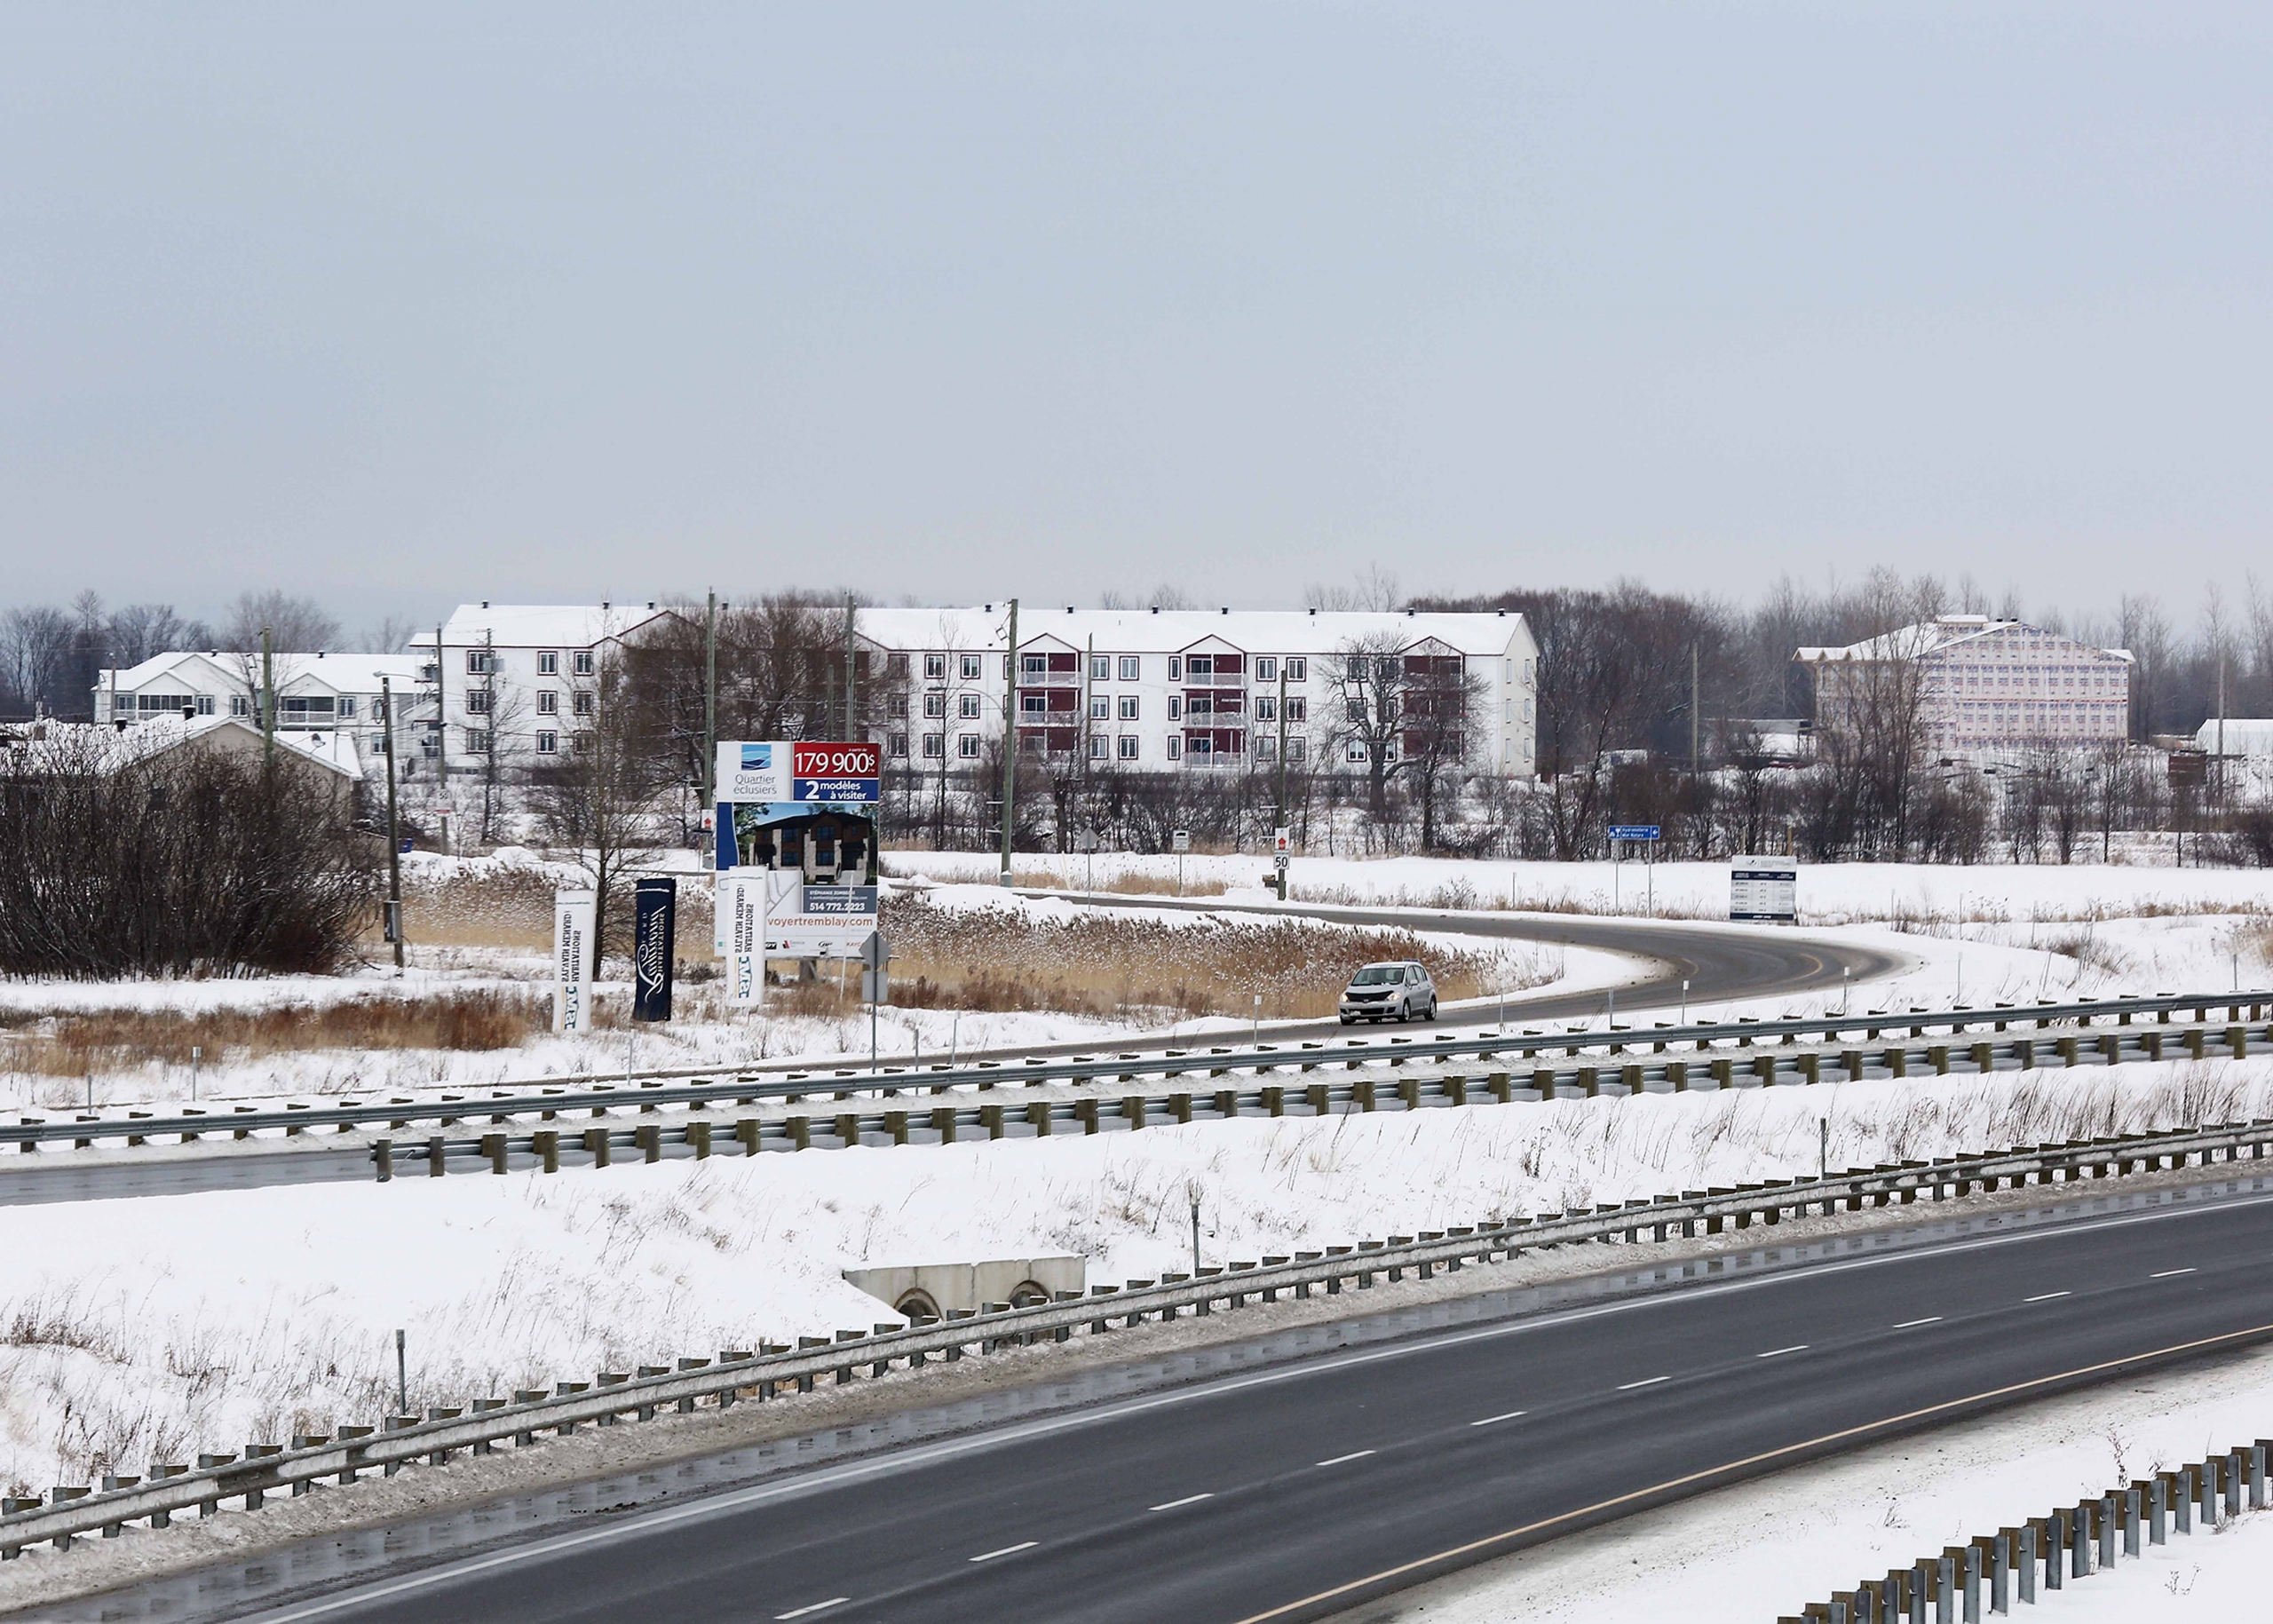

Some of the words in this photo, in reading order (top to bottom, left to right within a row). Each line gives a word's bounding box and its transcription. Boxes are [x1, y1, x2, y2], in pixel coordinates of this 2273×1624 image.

[795, 752, 828, 773] 179
[832, 752, 875, 773] 900$
[735, 774, 775, 785] Quartier
[733, 784, 777, 794] éclusiers
[805, 780, 820, 800] 2
[820, 781, 861, 790] modèles
[830, 791, 836, 800] à
[837, 791, 867, 800] visiter
[1275, 857, 1288, 868] 50
[768, 917, 873, 927] voyertremblaycom
